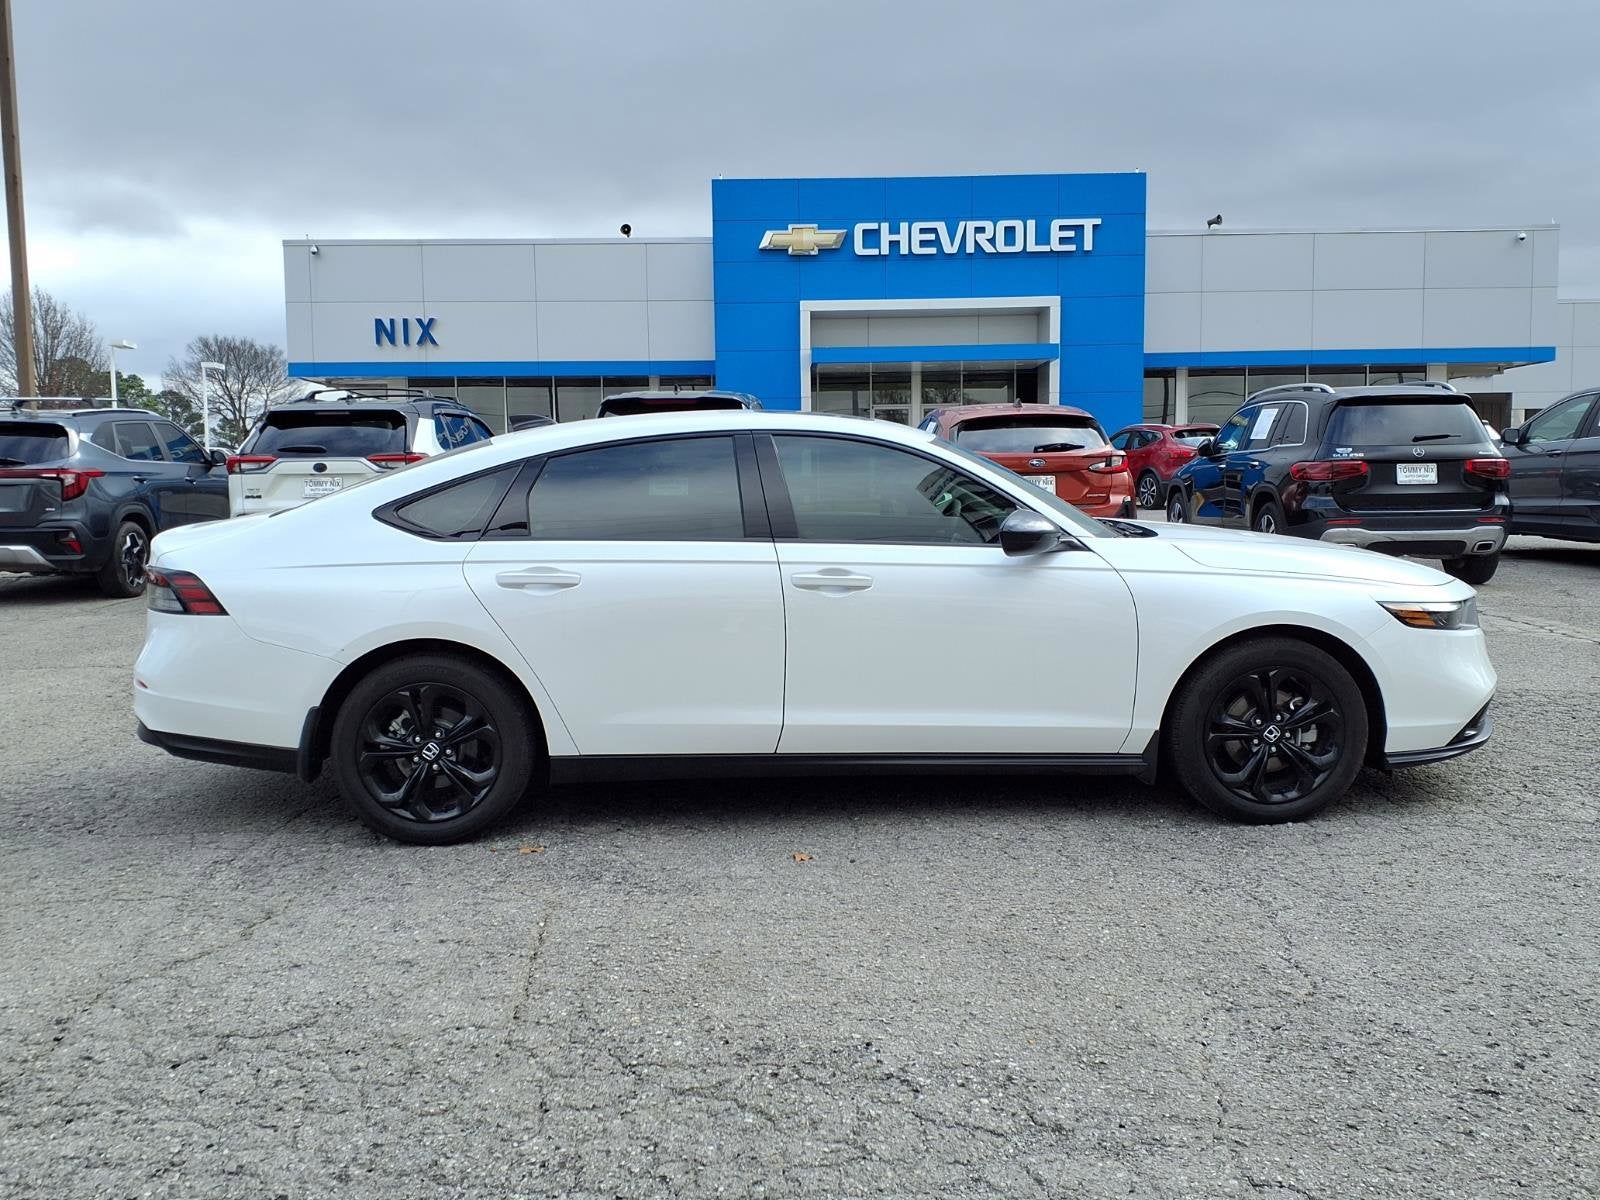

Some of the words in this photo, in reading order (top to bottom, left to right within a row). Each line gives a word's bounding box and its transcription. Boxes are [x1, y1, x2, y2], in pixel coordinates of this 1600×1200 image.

[853, 218, 1102, 256] CHEVROLET
[374, 317, 439, 346] NIX
[1398, 466, 1423, 474] TOMMY
[1424, 466, 1435, 474] NIX
[304, 480, 329, 488] TOMMY
[329, 480, 341, 488] NIX
